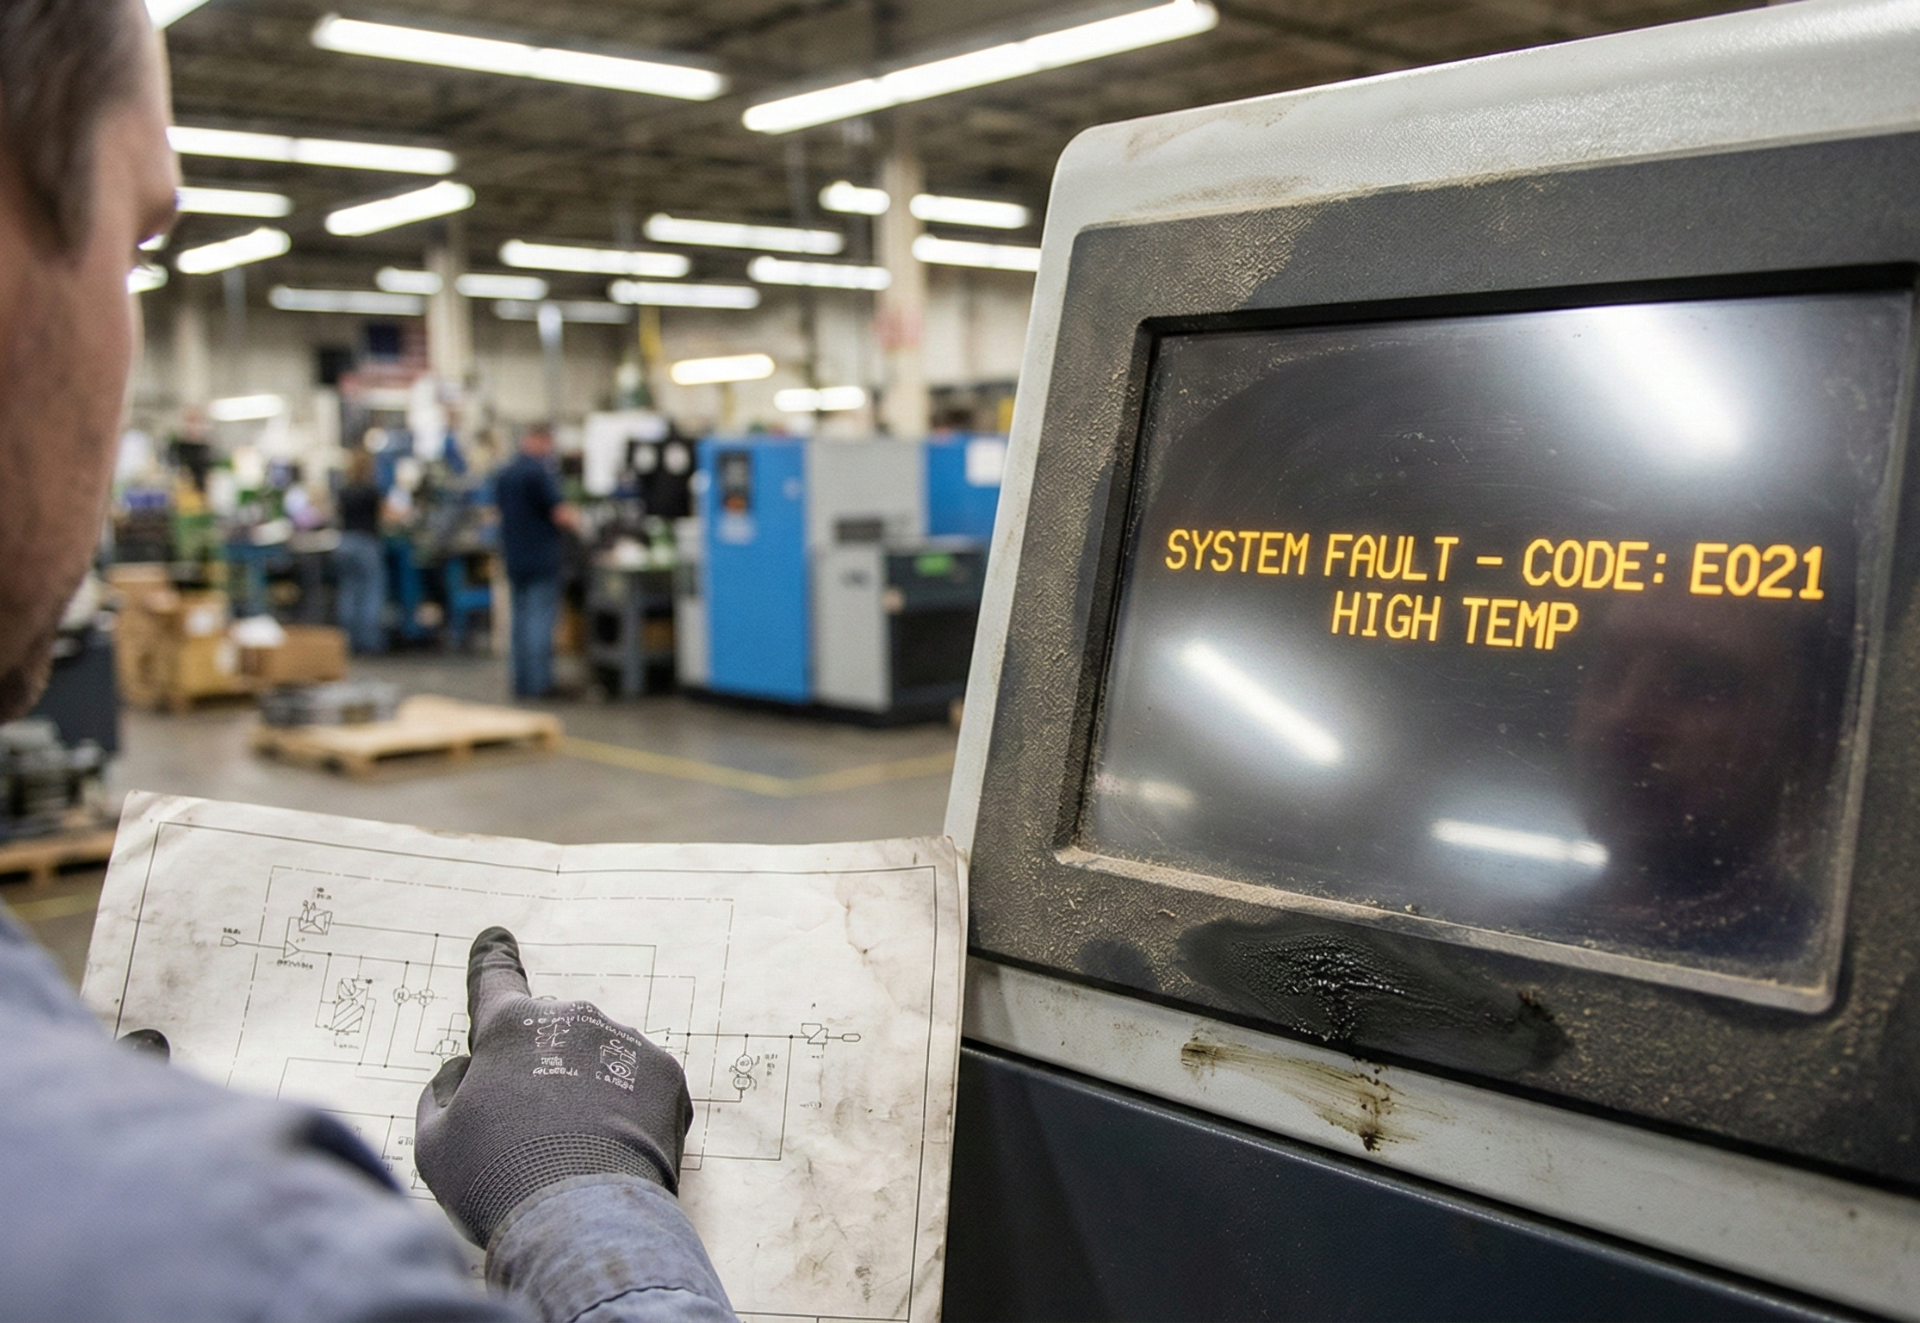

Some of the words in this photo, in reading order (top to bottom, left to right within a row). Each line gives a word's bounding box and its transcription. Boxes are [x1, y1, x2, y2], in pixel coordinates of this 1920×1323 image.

[1164, 528, 1311, 576] SYSTEM
[1323, 532, 1460, 582] FAULT
[1521, 537, 1668, 593] CODE:
[1688, 541, 1825, 601] E021
[1330, 589, 1442, 643] HIGH
[1461, 596, 1580, 651] TEMP
